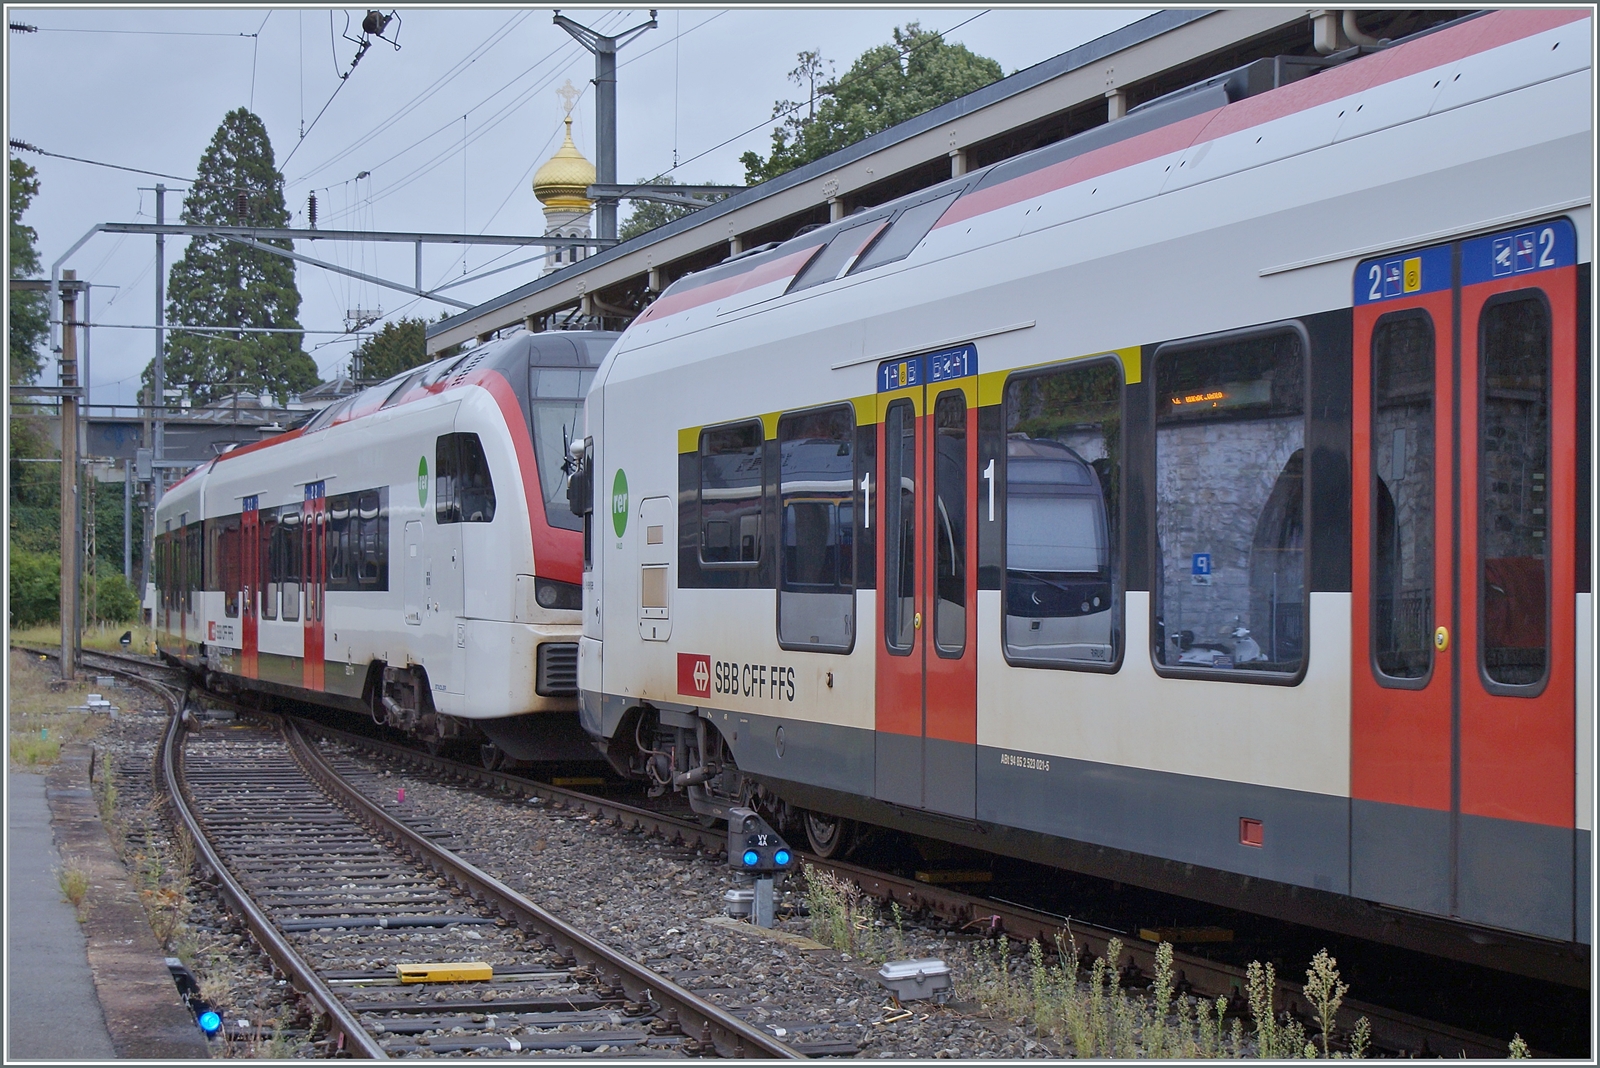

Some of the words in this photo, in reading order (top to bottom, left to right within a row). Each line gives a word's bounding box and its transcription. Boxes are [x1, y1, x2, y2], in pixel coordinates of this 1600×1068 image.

[1538, 227, 1555, 268] 2
[1368, 264, 1382, 300] 2
[884, 366, 889, 389] 1
[962, 350, 968, 375] 1
[419, 475, 427, 490] rer
[983, 458, 995, 522] 1
[613, 493, 628, 514] rer
[860, 472, 870, 529] 1
[715, 660, 739, 695] SBB
[742, 663, 767, 698] CFF
[770, 666, 795, 702] FFS
[1010, 754, 1016, 766] 94
[1023, 757, 1027, 768] 2
[1027, 757, 1036, 769] 523
